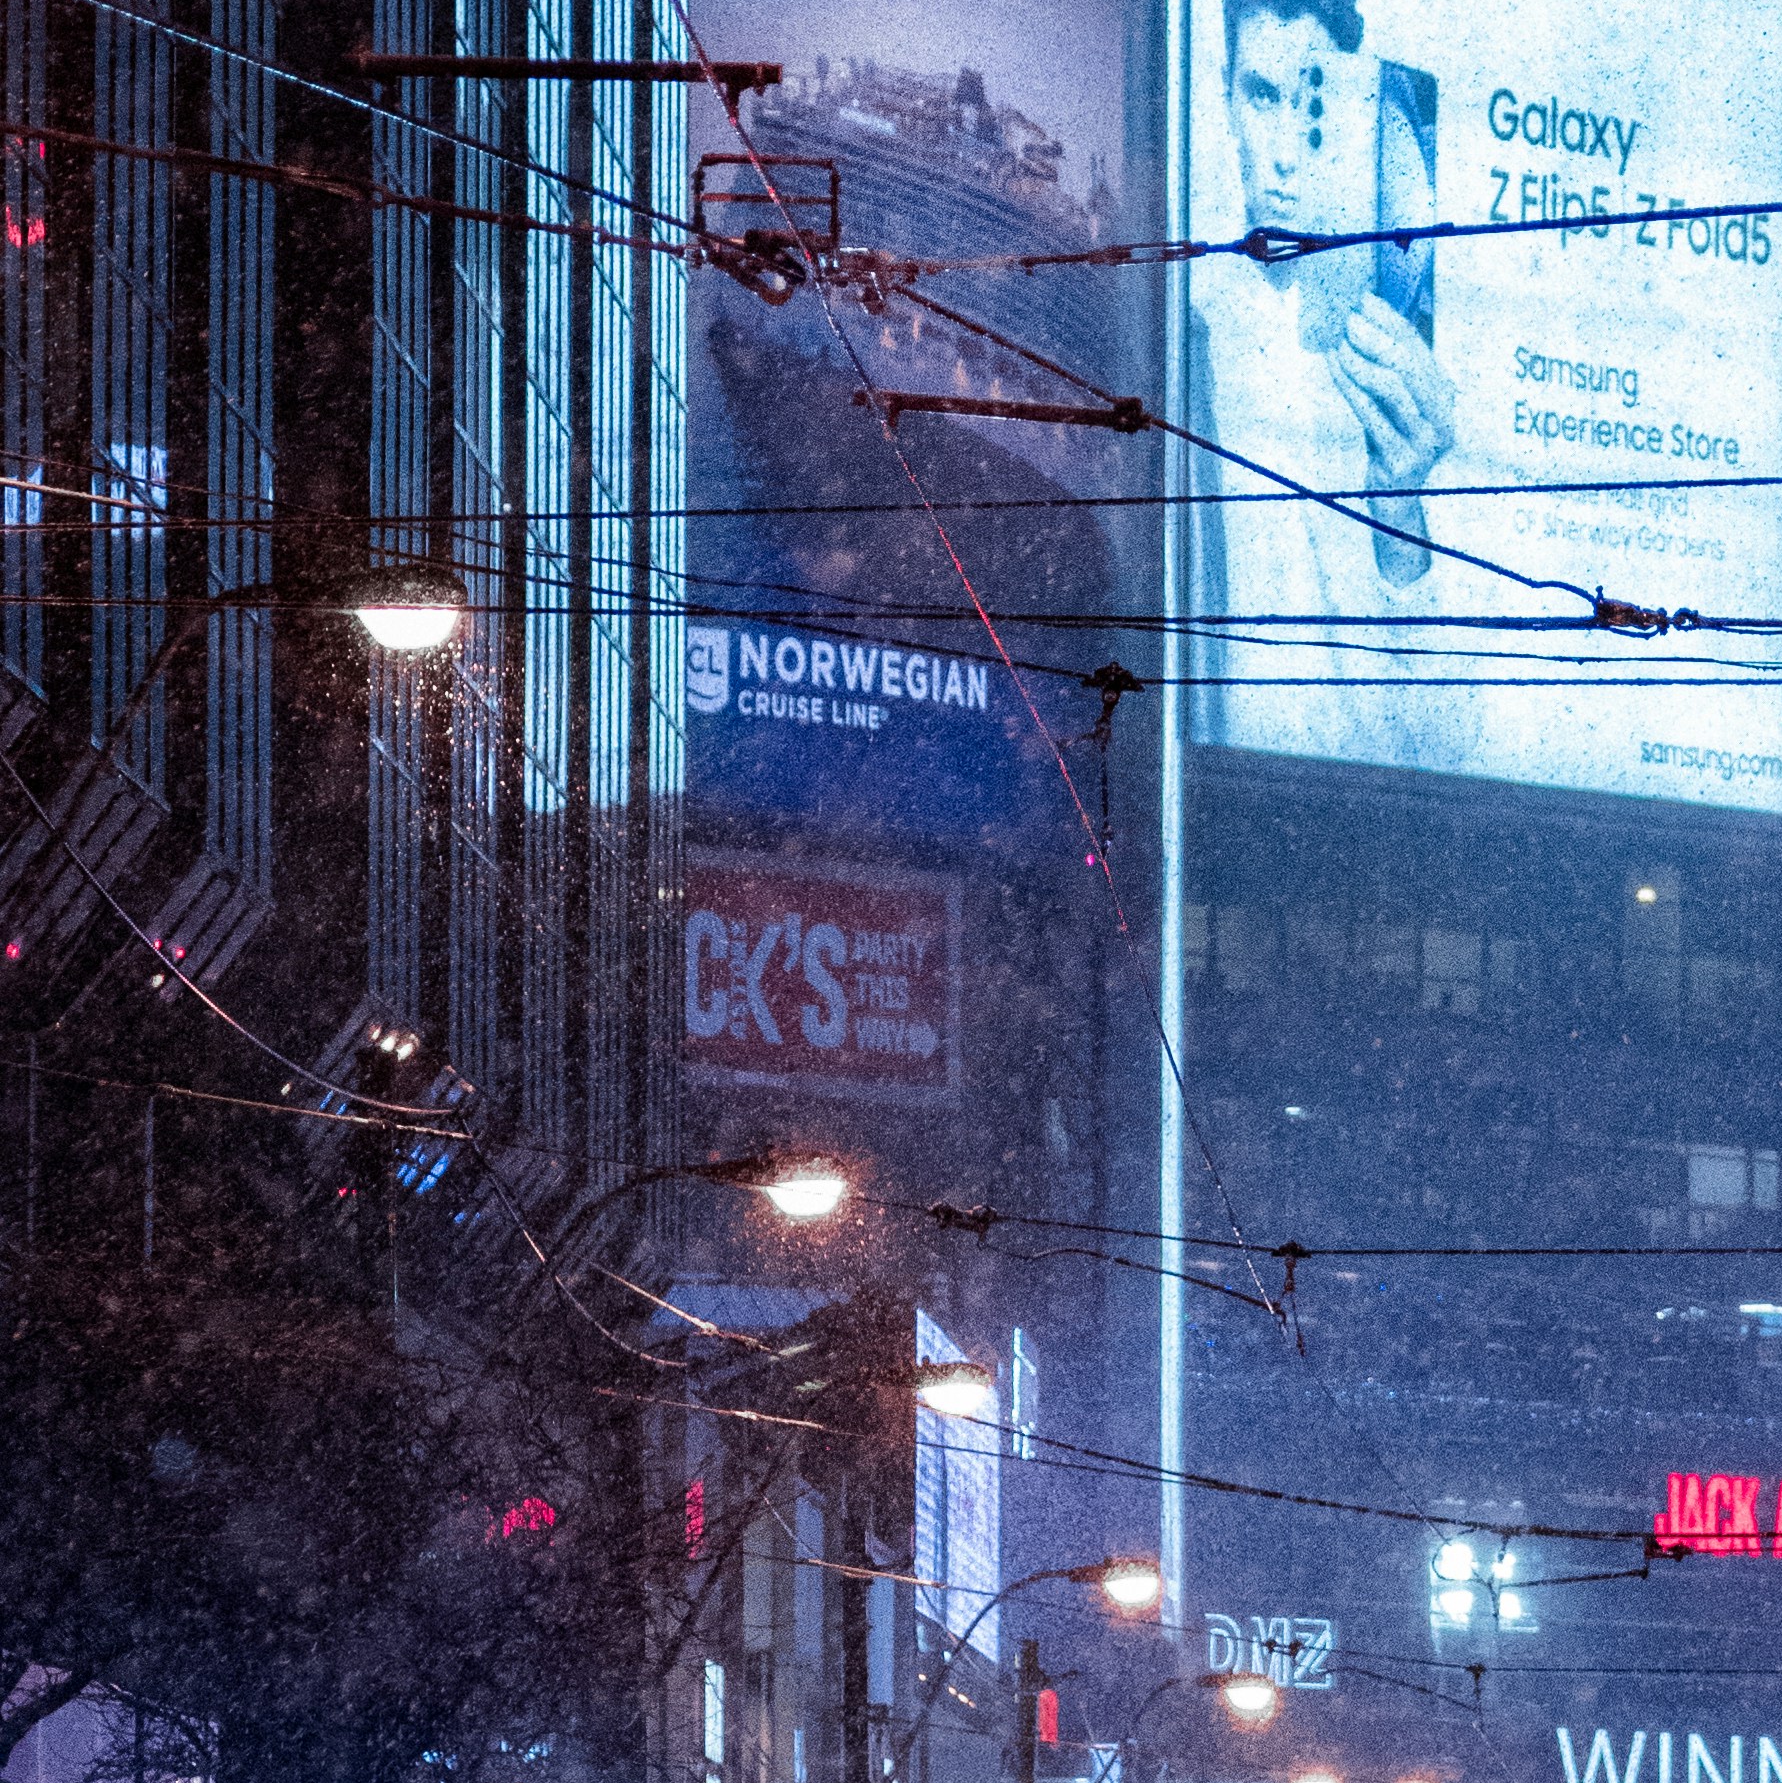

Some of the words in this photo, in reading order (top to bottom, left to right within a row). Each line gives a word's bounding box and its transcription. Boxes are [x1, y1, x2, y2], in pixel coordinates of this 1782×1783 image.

[1488, 89, 1638, 176] Galaxy
[1490, 167, 1509, 222] Z
[1521, 172, 1610, 249] Flip5
[1636, 194, 1656, 246] Z
[1668, 198, 1771, 265] Fold5
[1514, 346, 1639, 408] Samsung
[1514, 400, 1663, 455] Experience
[1670, 423, 1740, 465] Store
[738, 690, 824, 723] CRUISE
[739, 633, 987, 710] NORWEGIAN
[853, 930, 928, 974] PARTY
[855, 973, 909, 1010] THIS
[1654, 1472, 1760, 1559] JACK
[1205, 1612, 1336, 1690] DMZ
